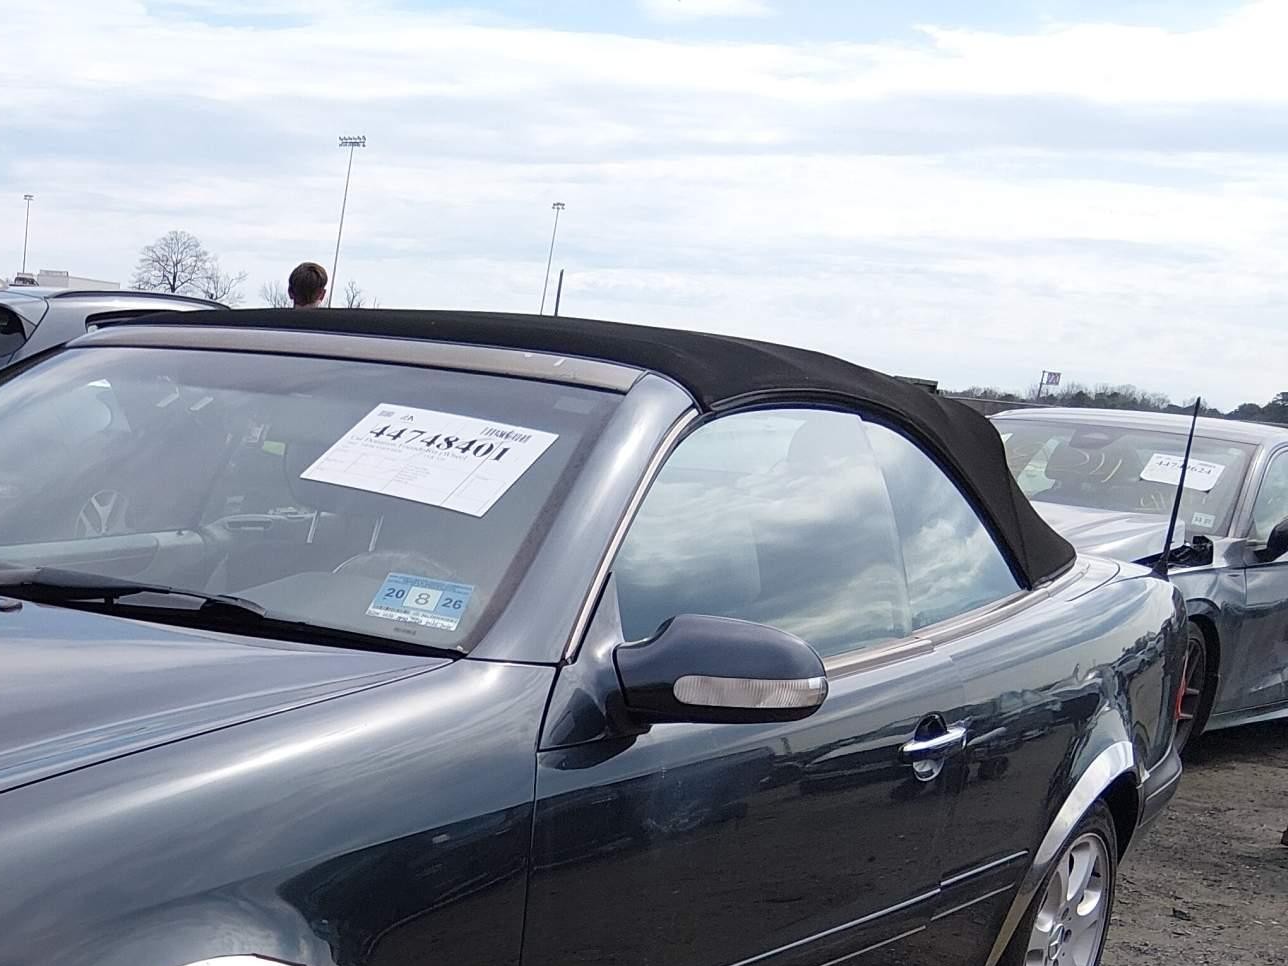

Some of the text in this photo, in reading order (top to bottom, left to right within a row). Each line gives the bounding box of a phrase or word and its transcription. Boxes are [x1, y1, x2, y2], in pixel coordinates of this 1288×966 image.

[370, 424, 510, 461] 44748401
[384, 587, 463, 610] 20 8 26
